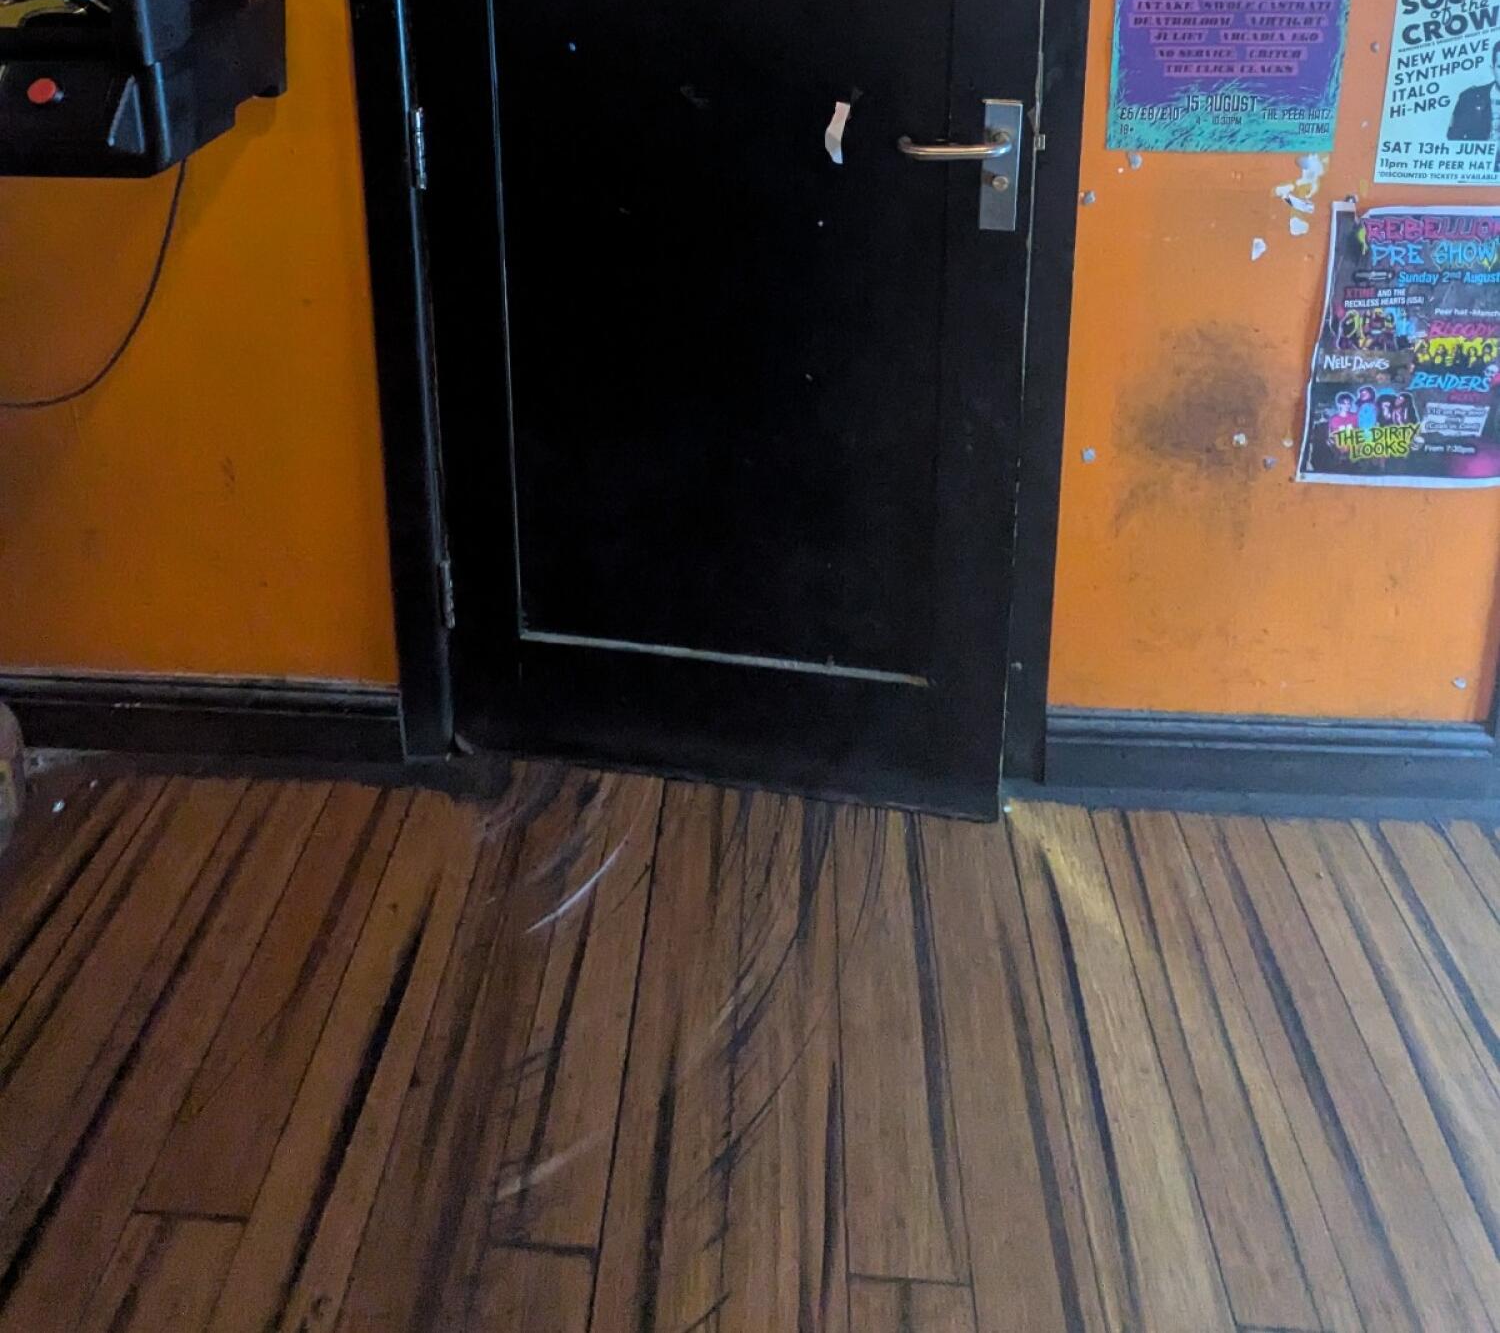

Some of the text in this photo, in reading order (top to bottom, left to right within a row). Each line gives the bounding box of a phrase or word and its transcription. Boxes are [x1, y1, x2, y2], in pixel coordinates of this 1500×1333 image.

[1431, 0, 1451, 26] of
[1397, 39, 1489, 69] NEW WAVE
[1394, 56, 1484, 85] SYNTHPOP
[1392, 82, 1440, 102] ITALO
[1206, 95, 1257, 113] AUGUST
[1390, 95, 1450, 118] Hi-NRG
[1382, 141, 1495, 155] SAT 13th JUNE
[1380, 158, 1492, 170] 11pm THE PEER HAT
[1371, 240, 1497, 267] PRE SHOW
[1398, 272, 1440, 285] Sunday
[1345, 298, 1379, 307] RECKLESS
[1381, 297, 1405, 305] HEARTS
[1377, 289, 1391, 297] AND
[1394, 288, 1405, 296] THE
[1429, 320, 1496, 338] BLOODY
[1409, 372, 1490, 392] BENDERS
[1334, 424, 1420, 446] THE DIRTY
[1352, 441, 1408, 458] LOOKS
